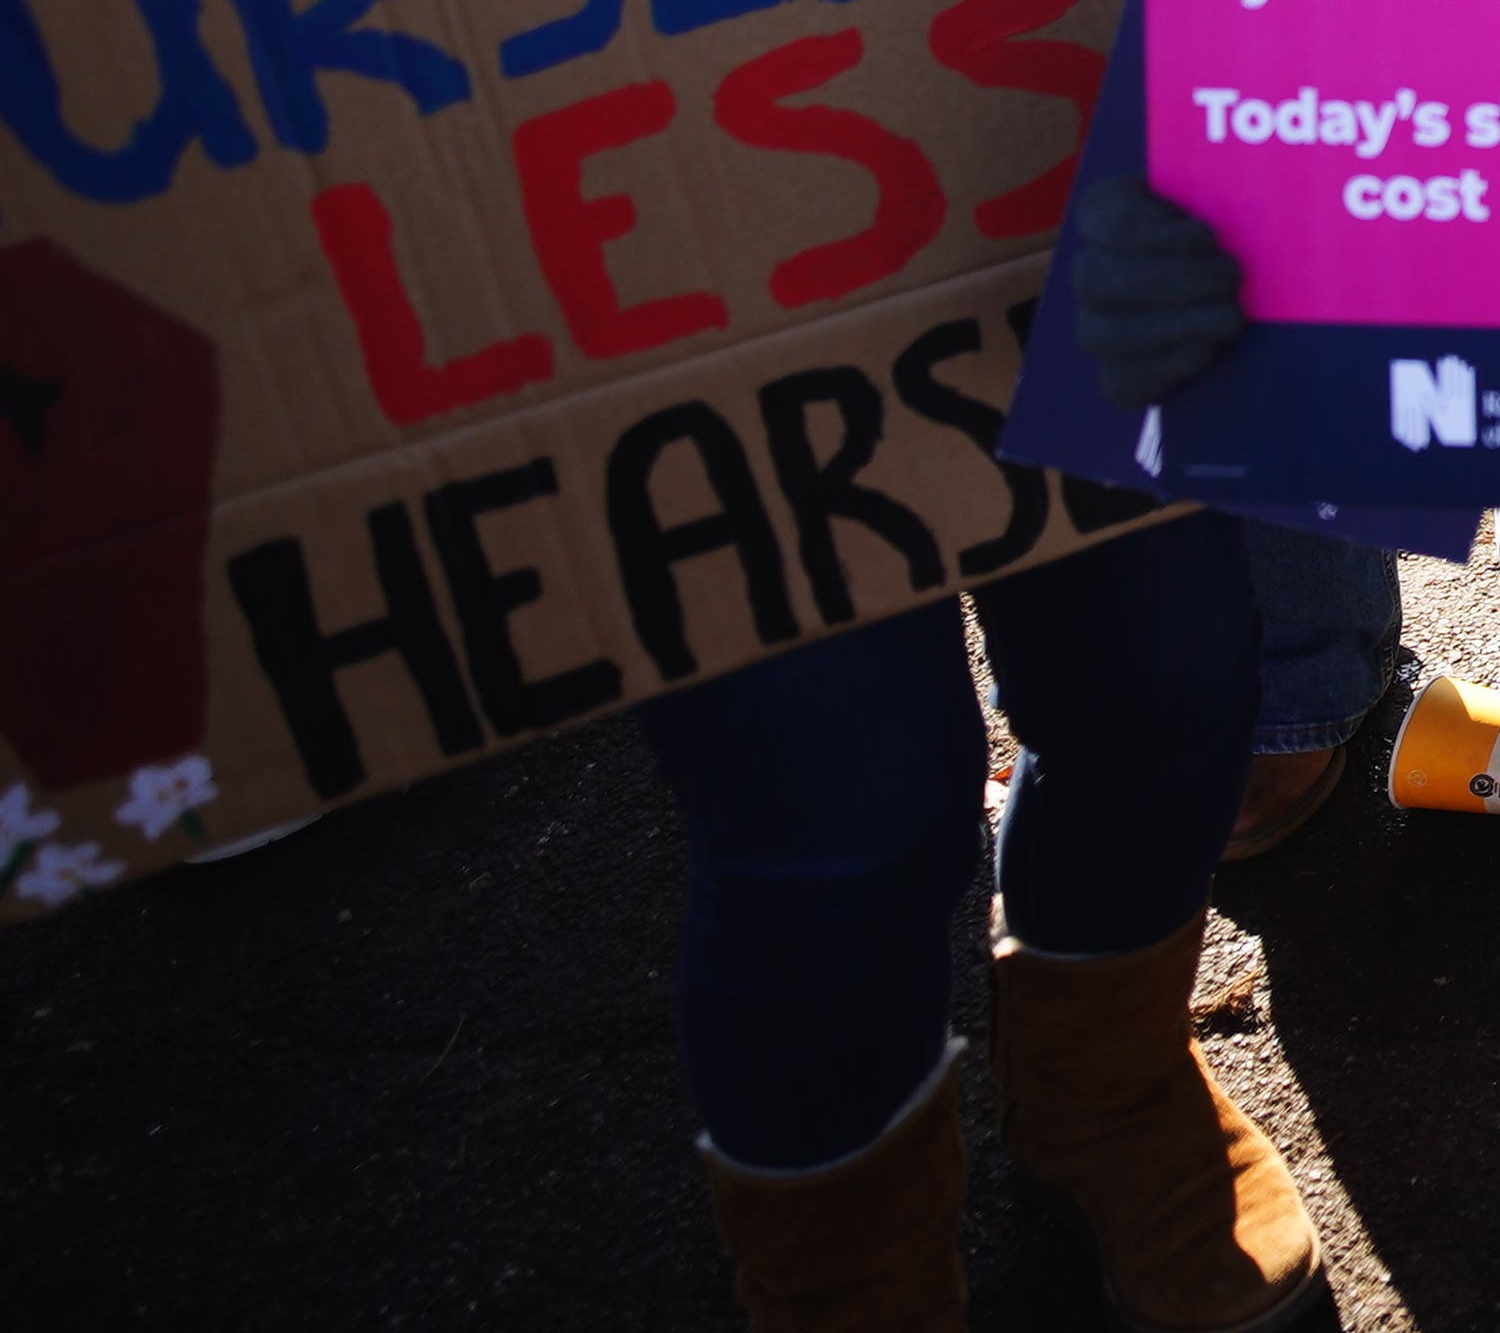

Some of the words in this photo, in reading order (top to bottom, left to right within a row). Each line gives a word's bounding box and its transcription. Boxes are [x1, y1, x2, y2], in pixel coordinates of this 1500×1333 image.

[1193, 87, 1452, 159] Today's
[1342, 170, 1490, 224] cost
[227, 303, 1167, 805] HEARS
